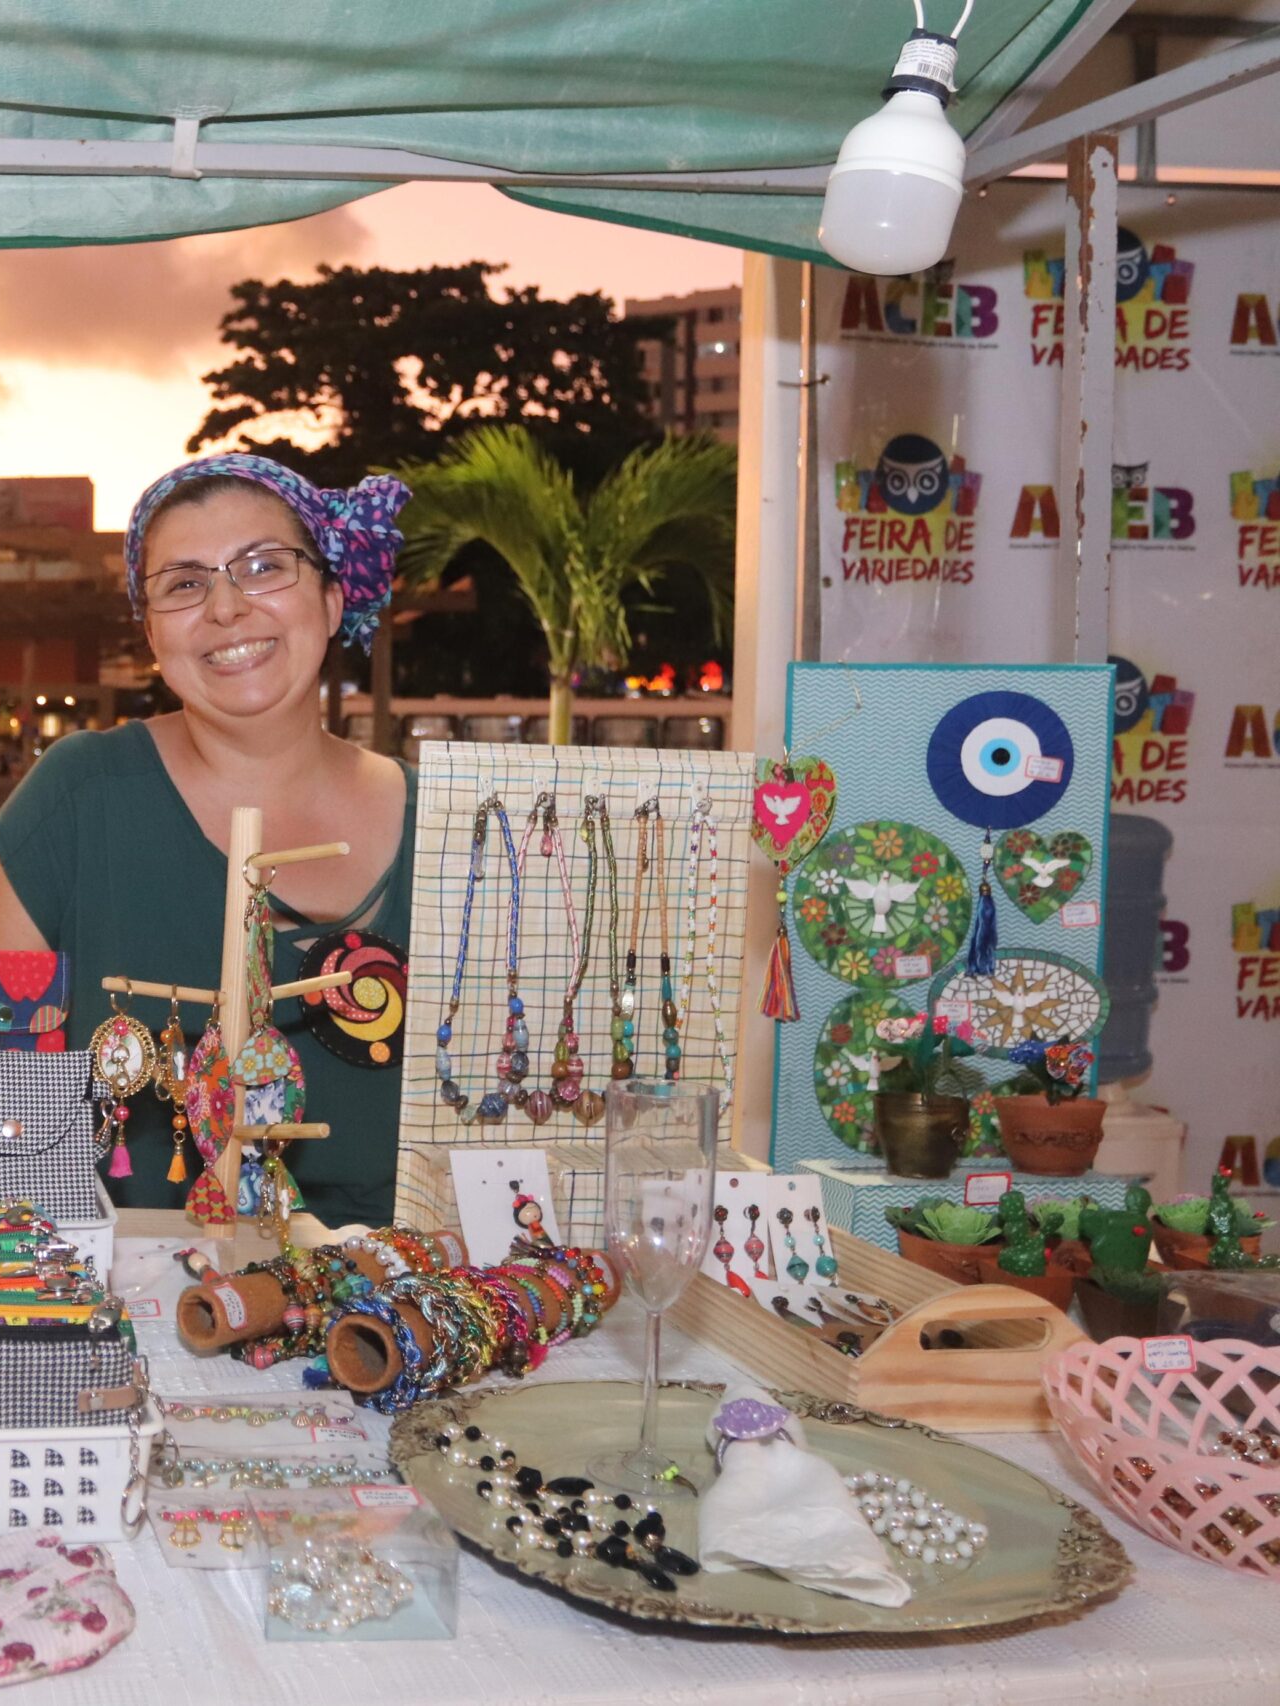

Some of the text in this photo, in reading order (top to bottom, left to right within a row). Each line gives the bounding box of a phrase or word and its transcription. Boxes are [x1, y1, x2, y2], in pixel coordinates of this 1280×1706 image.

[840, 275, 999, 338] ACEB
[1144, 308, 1189, 340] DE
[1009, 485, 1196, 540] AEB
[843, 517, 975, 555] FEIRA DE
[842, 556, 974, 586] VARIEDADES
[1140, 739, 1188, 772] DE
